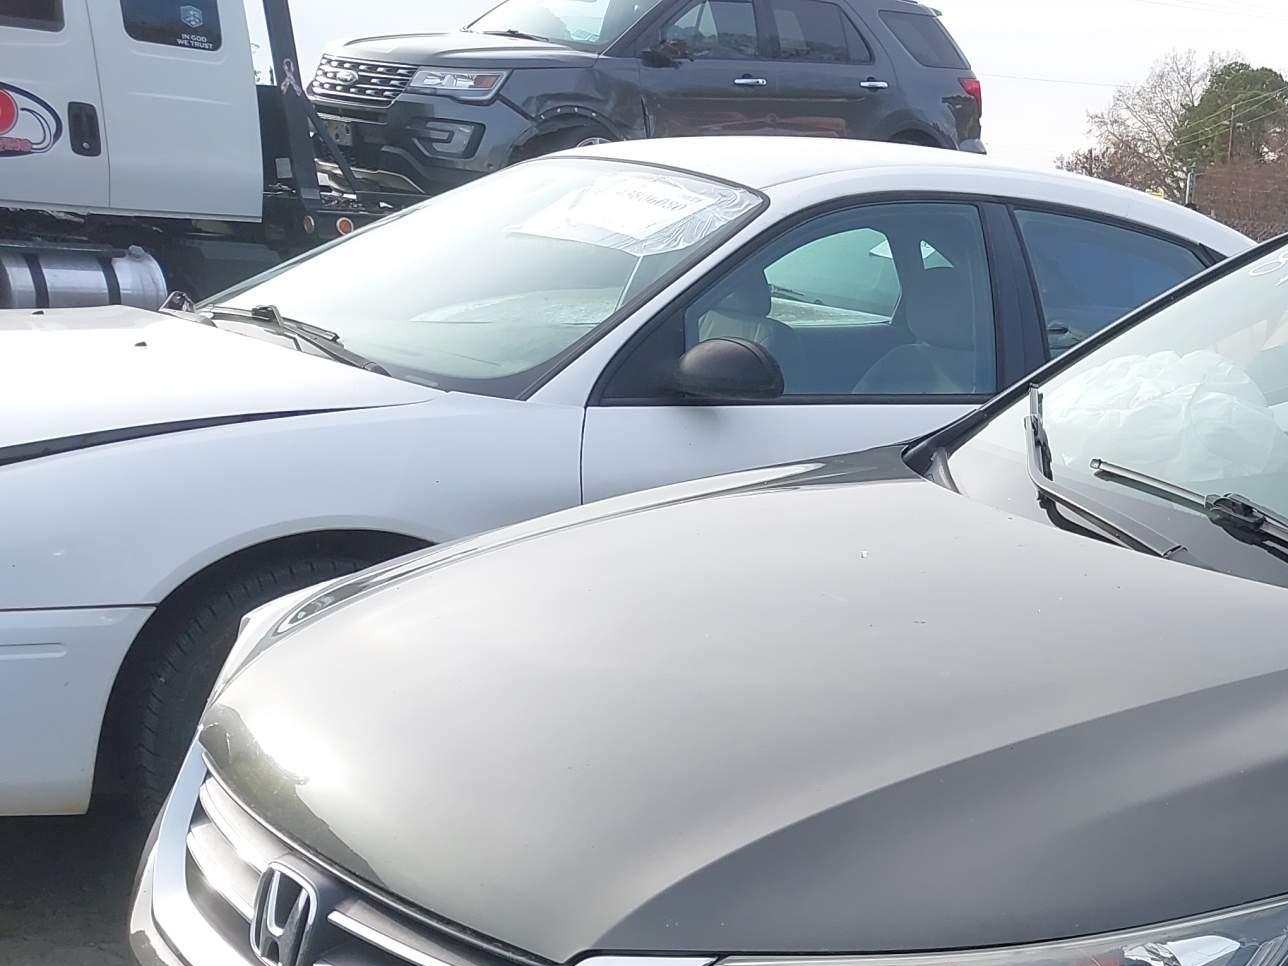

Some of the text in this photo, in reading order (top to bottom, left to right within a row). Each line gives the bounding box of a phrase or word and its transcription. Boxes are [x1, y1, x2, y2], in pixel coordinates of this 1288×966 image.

[176, 38, 214, 49] WE TRUST
[190, 35, 208, 43] GOD
